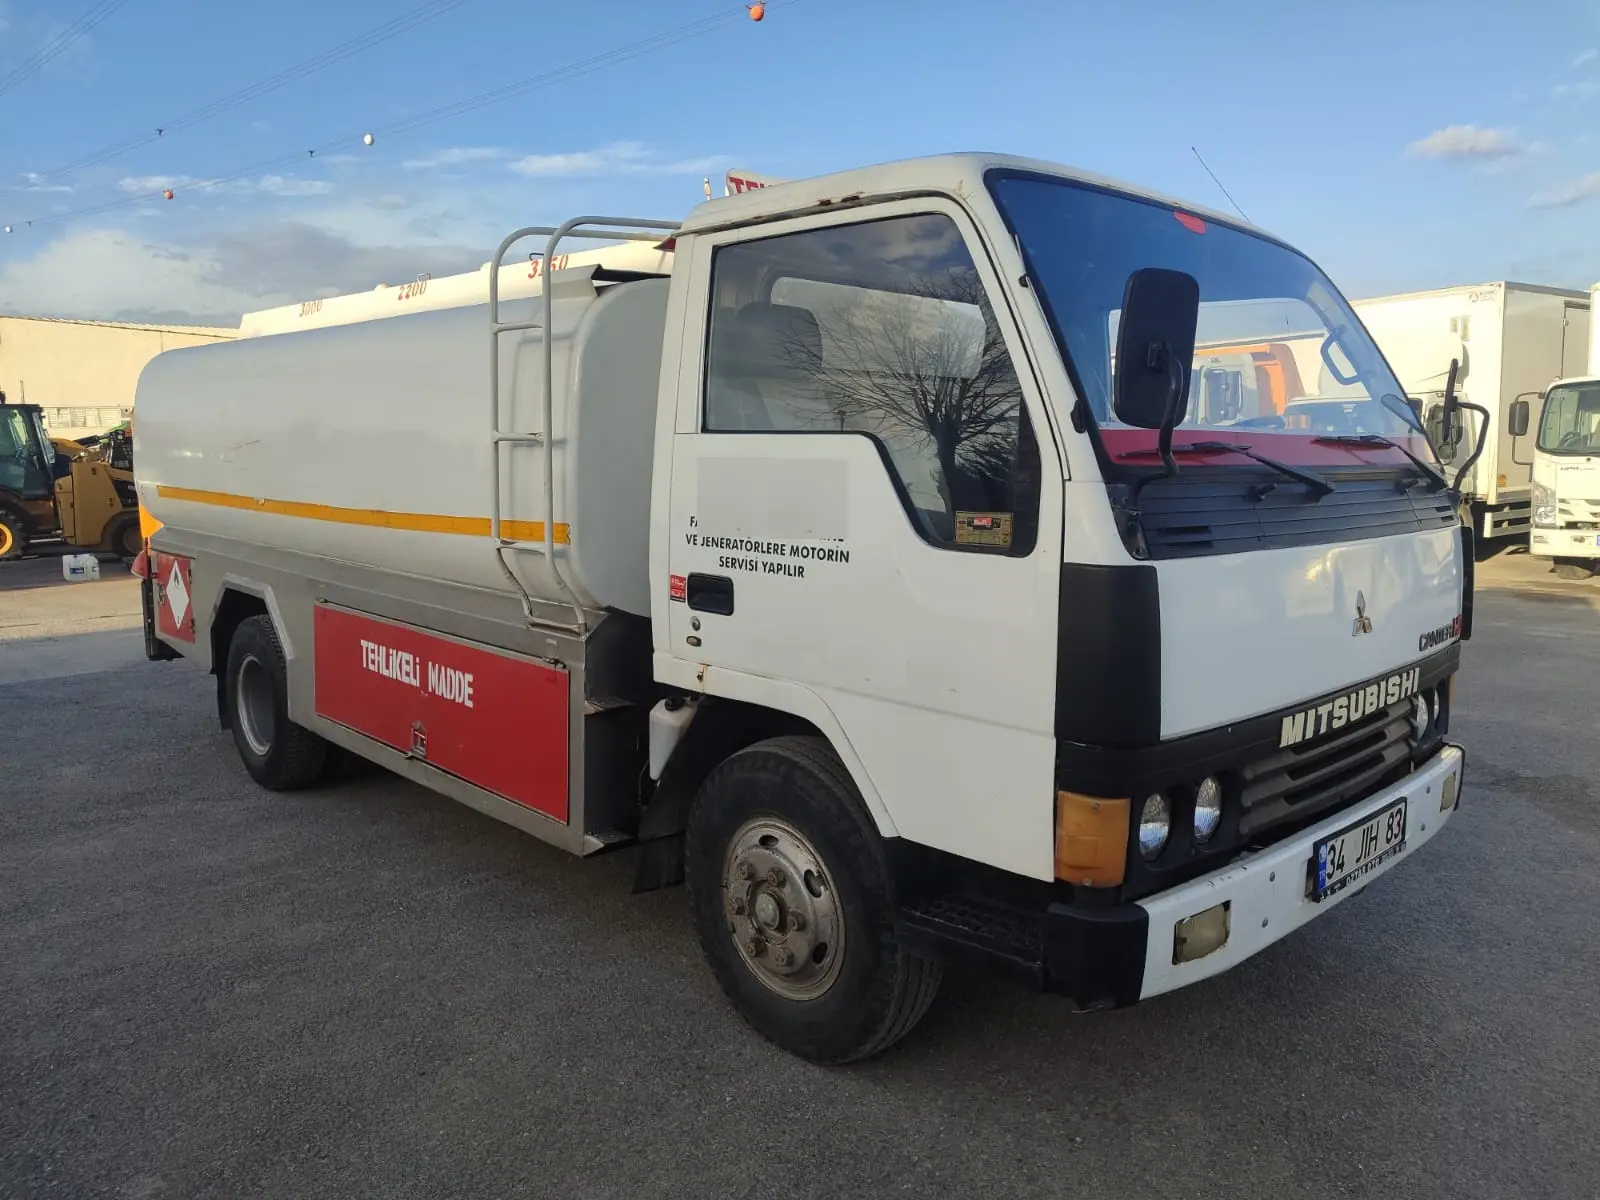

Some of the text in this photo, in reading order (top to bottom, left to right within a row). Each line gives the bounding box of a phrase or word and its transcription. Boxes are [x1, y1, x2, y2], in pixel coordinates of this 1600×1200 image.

[398, 280, 427, 300] 2200
[299, 300, 322, 317] 3000
[685, 533, 850, 563] VE JENERATÖRLERE MOTORİN
[719, 555, 805, 578] SERVİSİ YAPILIR
[428, 661, 473, 708] MADDE
[1279, 667, 1420, 748] MITSUBISHI
[1327, 839, 1345, 880] 34
[1355, 820, 1380, 863] JIH
[1385, 807, 1402, 844] 83
